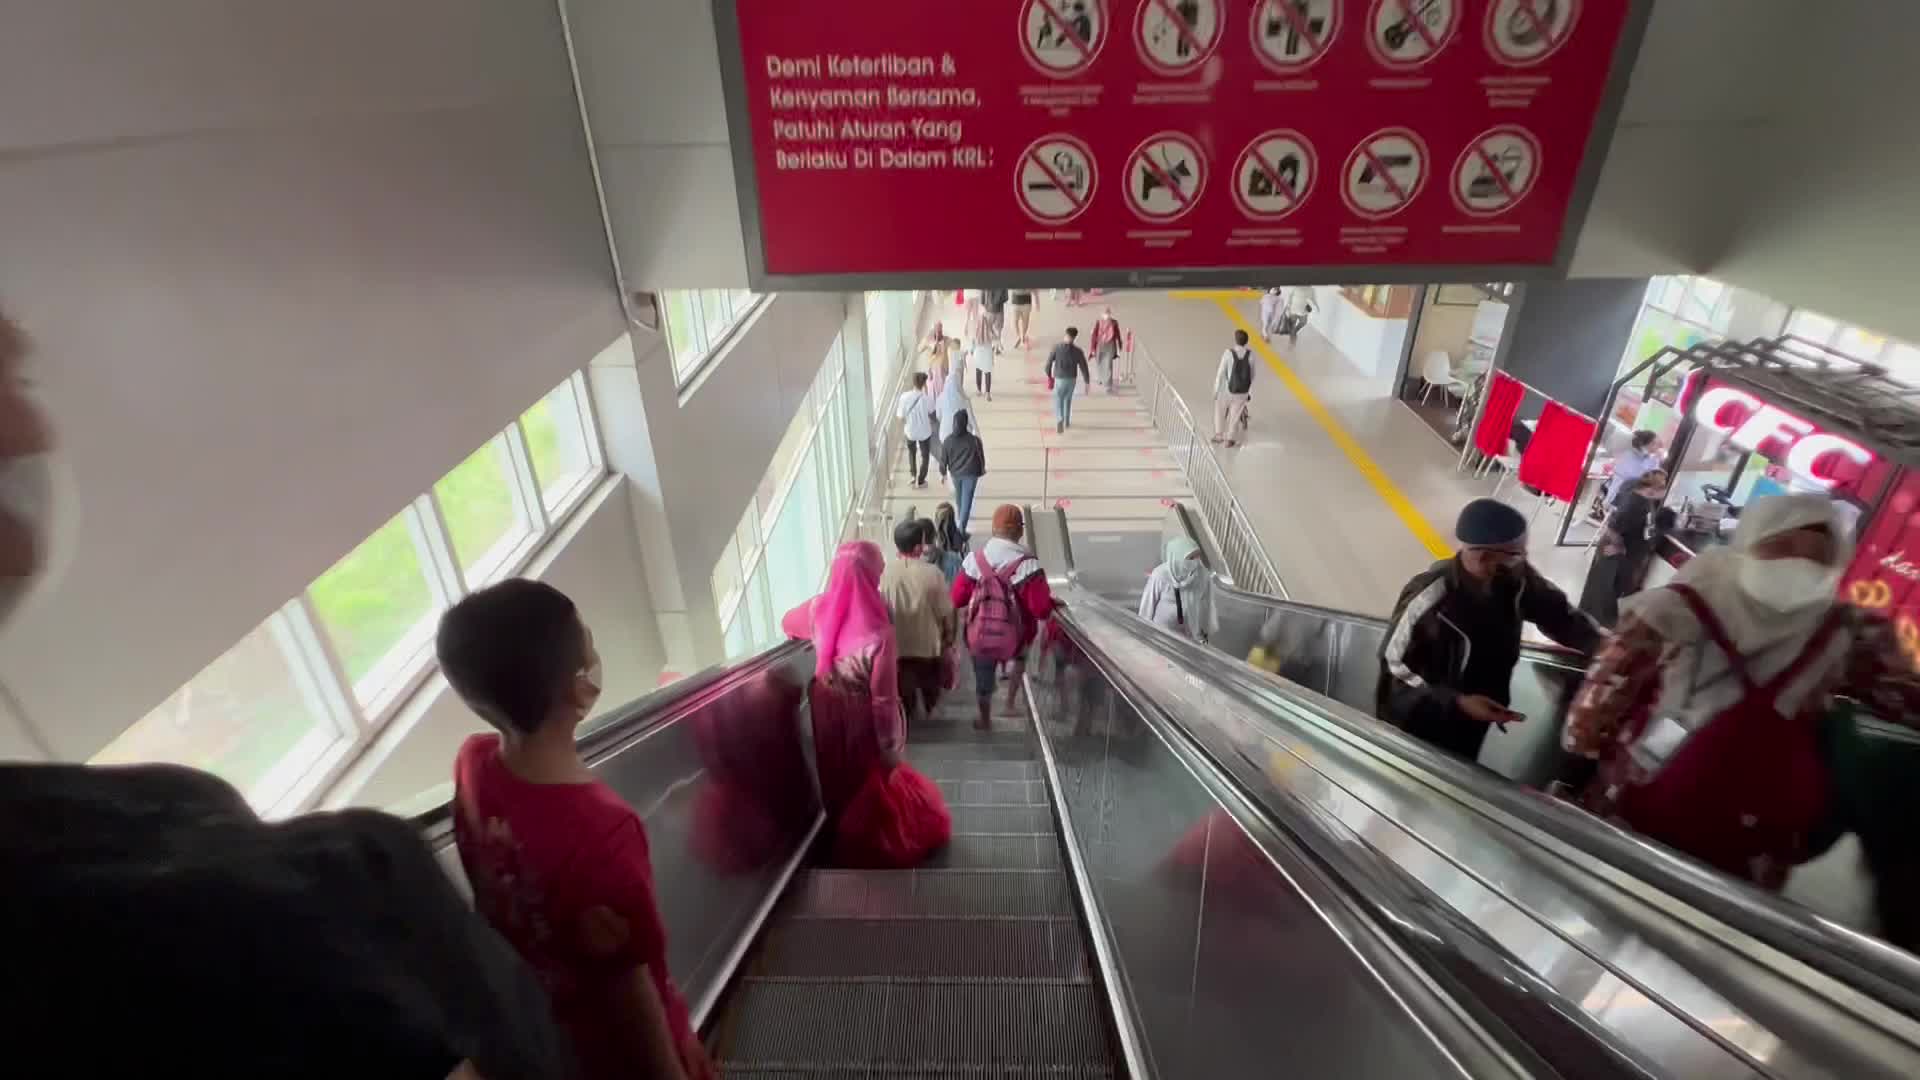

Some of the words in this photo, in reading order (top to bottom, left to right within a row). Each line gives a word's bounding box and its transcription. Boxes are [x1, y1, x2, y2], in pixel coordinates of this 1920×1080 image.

[767, 55, 821, 78] Demi
[828, 54, 934, 77] Ketertiban
[941, 53, 957, 76] &
[770, 86, 881, 112] Kenyaman
[887, 84, 982, 108] Bersama,
[773, 118, 834, 140] Patuhi
[841, 118, 905, 139] Aturan
[912, 117, 962, 142] Yang
[776, 149, 847, 169] Berlaku
[854, 148, 873, 168] Di
[880, 148, 946, 168] Dalam
[1696, 387, 1874, 492] CFC
